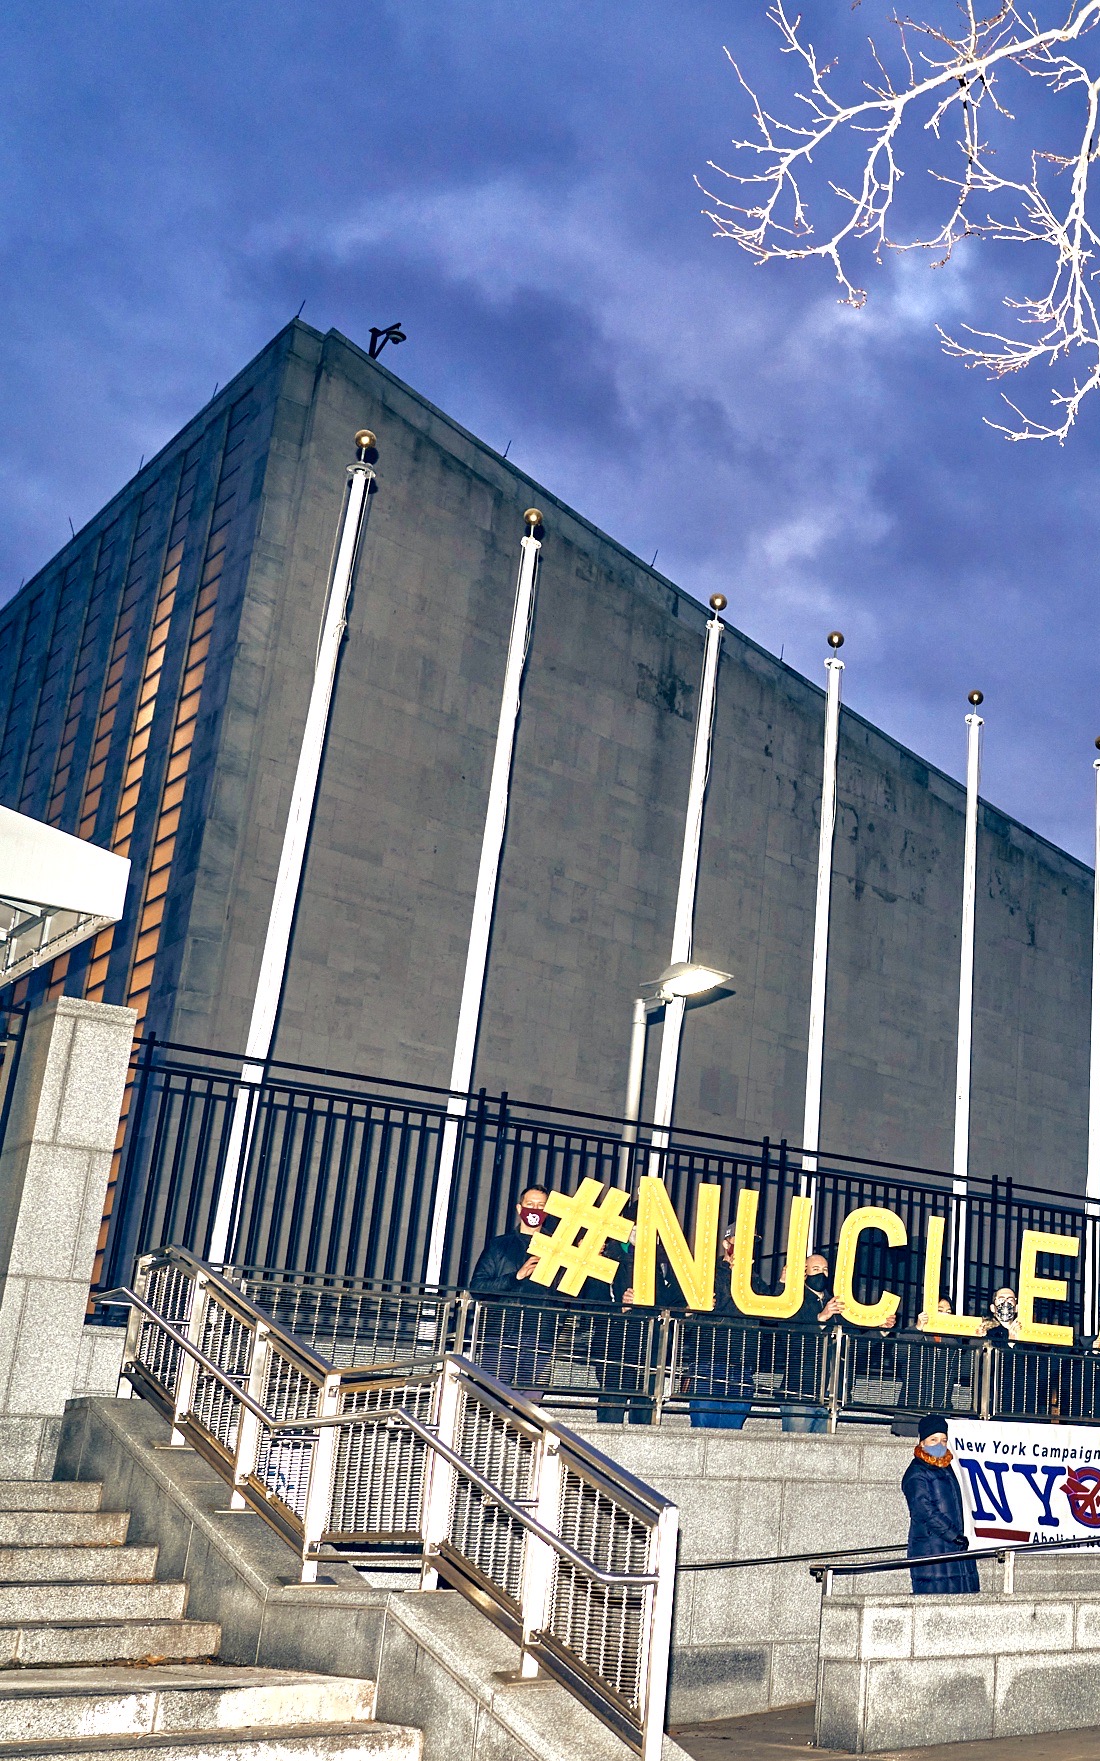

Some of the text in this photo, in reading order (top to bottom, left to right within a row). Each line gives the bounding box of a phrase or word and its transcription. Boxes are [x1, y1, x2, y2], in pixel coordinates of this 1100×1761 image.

[955, 1437, 986, 1453] New
[992, 1440, 1027, 1456] York
[1032, 1443, 1100, 1463] Campaign
